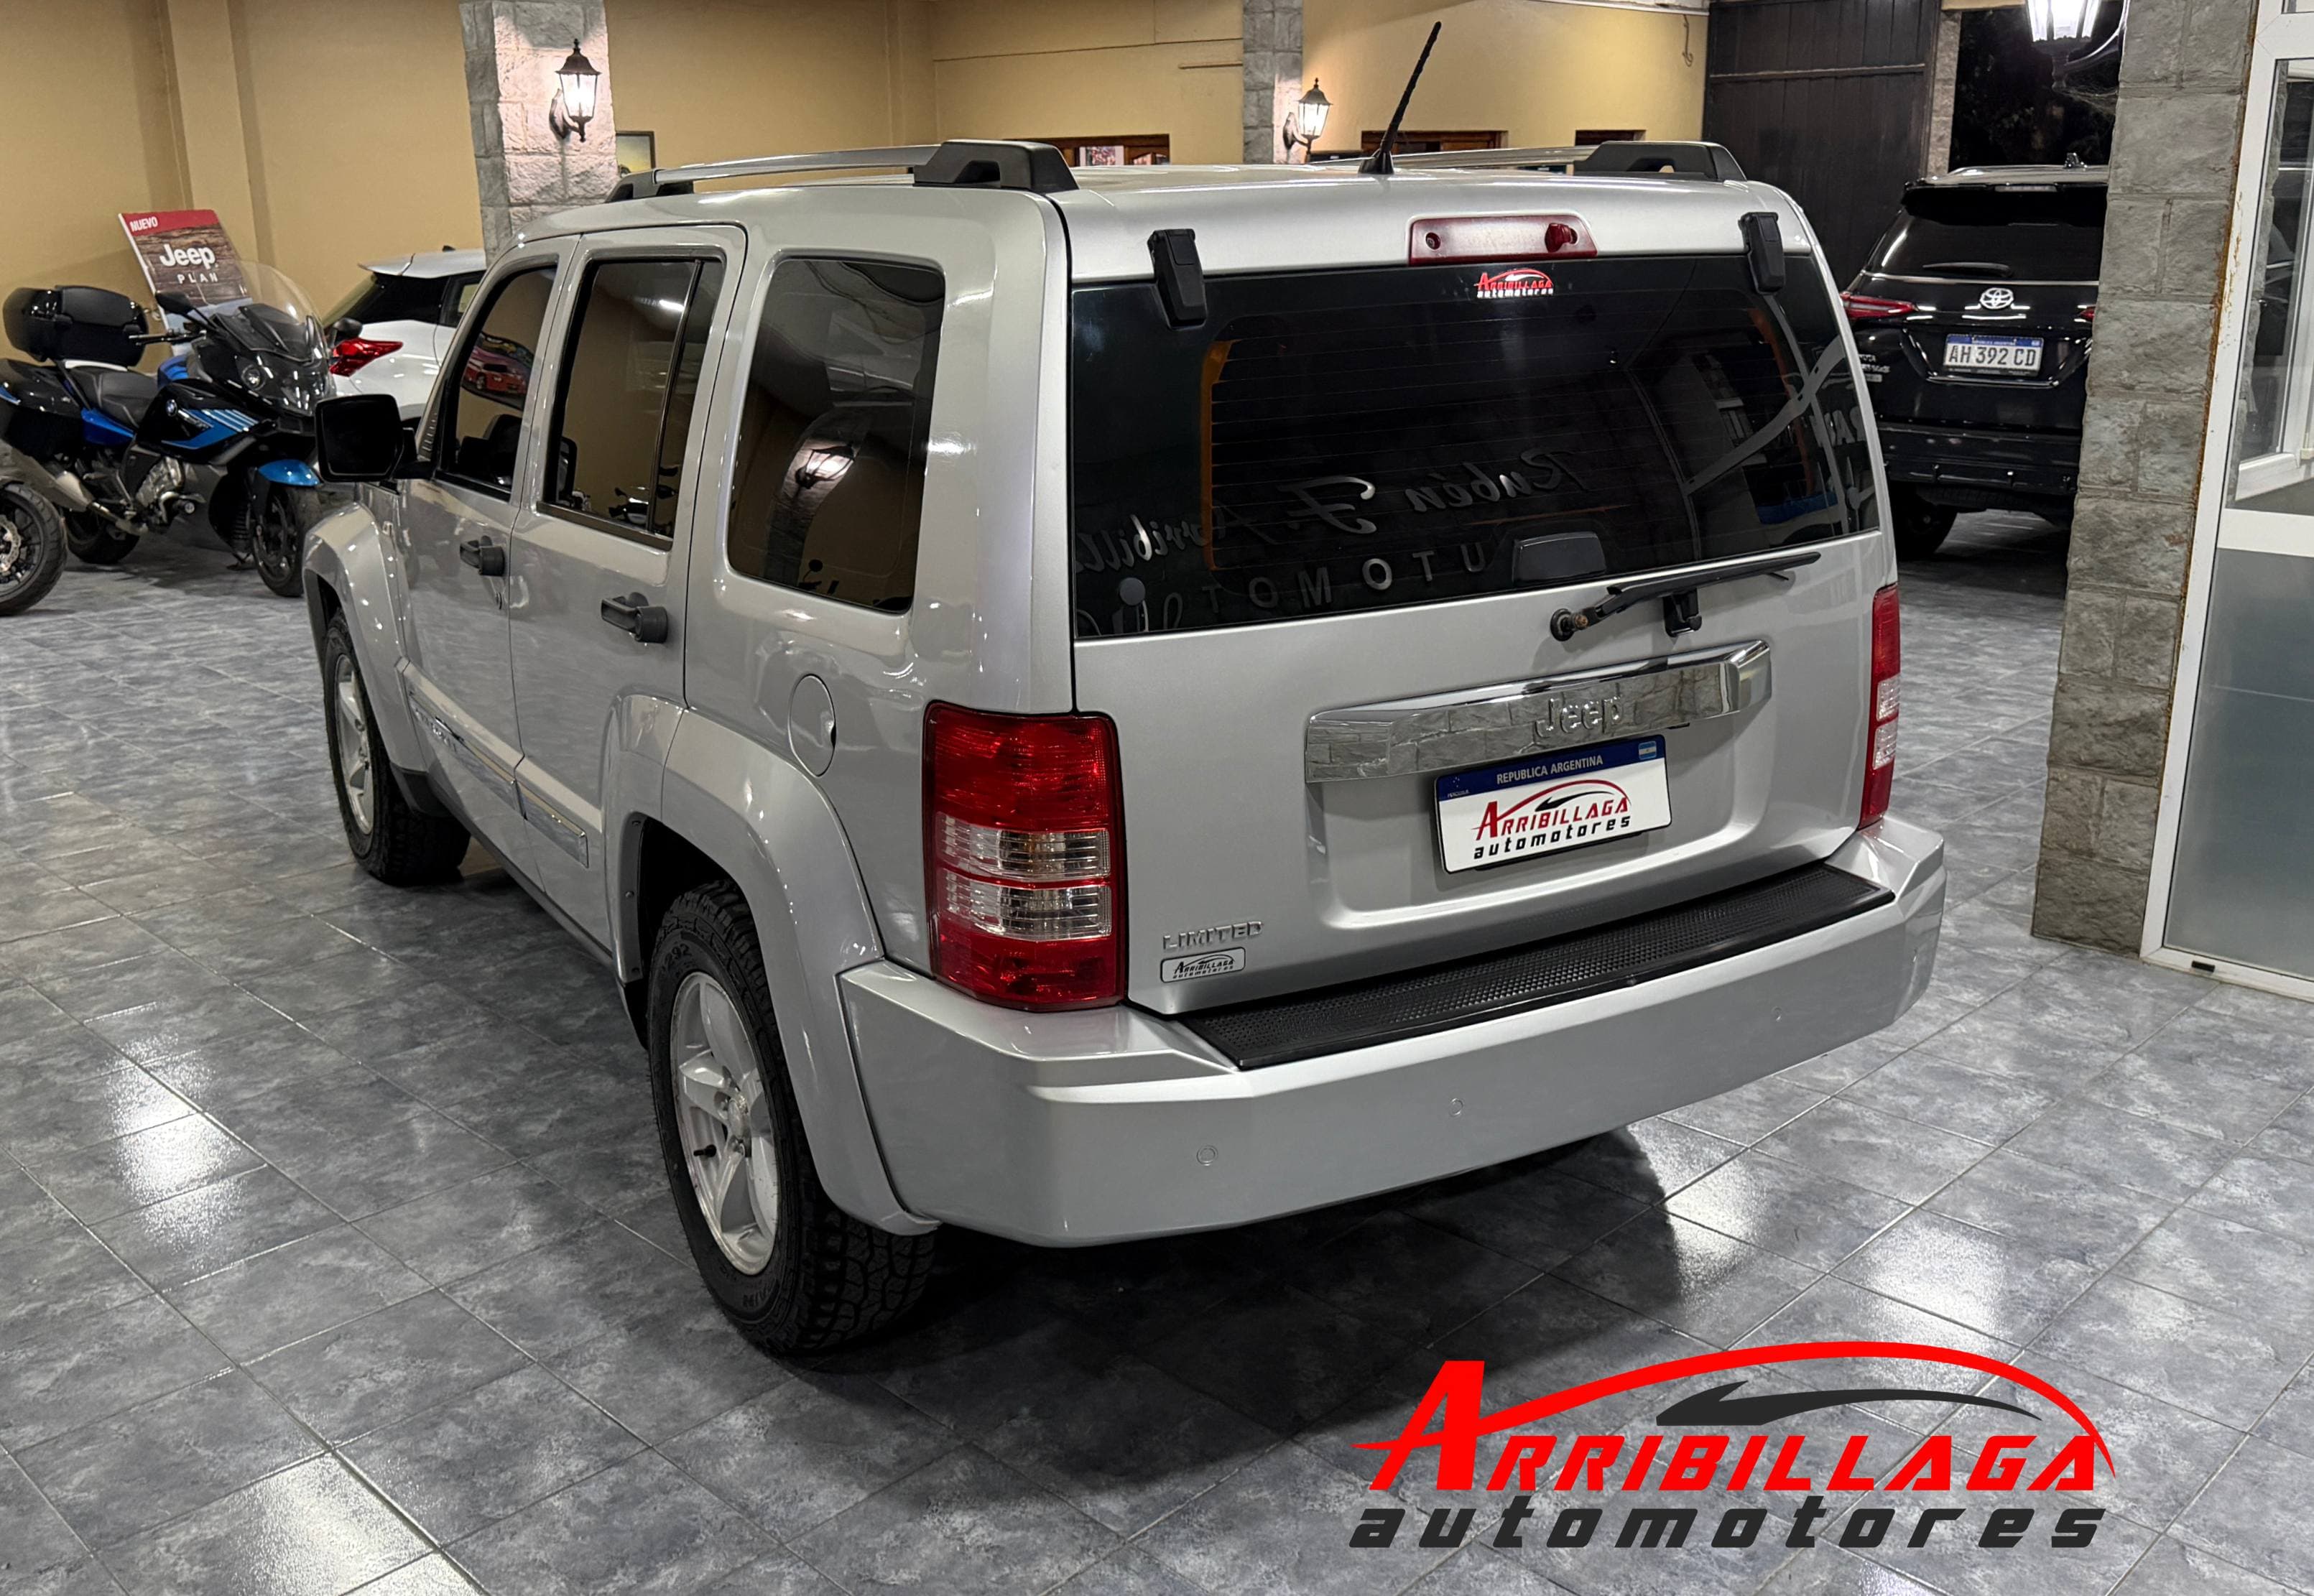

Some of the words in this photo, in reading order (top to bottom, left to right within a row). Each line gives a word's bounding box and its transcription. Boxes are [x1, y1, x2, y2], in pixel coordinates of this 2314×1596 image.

[129, 216, 158, 232] NUEVO
[159, 243, 216, 270] Jeep
[177, 272, 218, 284] PLAN
[1948, 345, 1971, 363] AH
[1976, 346, 2009, 365] 392
[2014, 348, 2036, 366] CD
[1535, 695, 1622, 738] Jeep
[1496, 766, 1548, 785] REPUBLICA
[1550, 754, 1603, 774] ARGENTINA
[1476, 797, 1629, 841] ARRIBILLAGA
[1473, 816, 1631, 860] automotores
[1163, 922, 1262, 950] LIMITED
